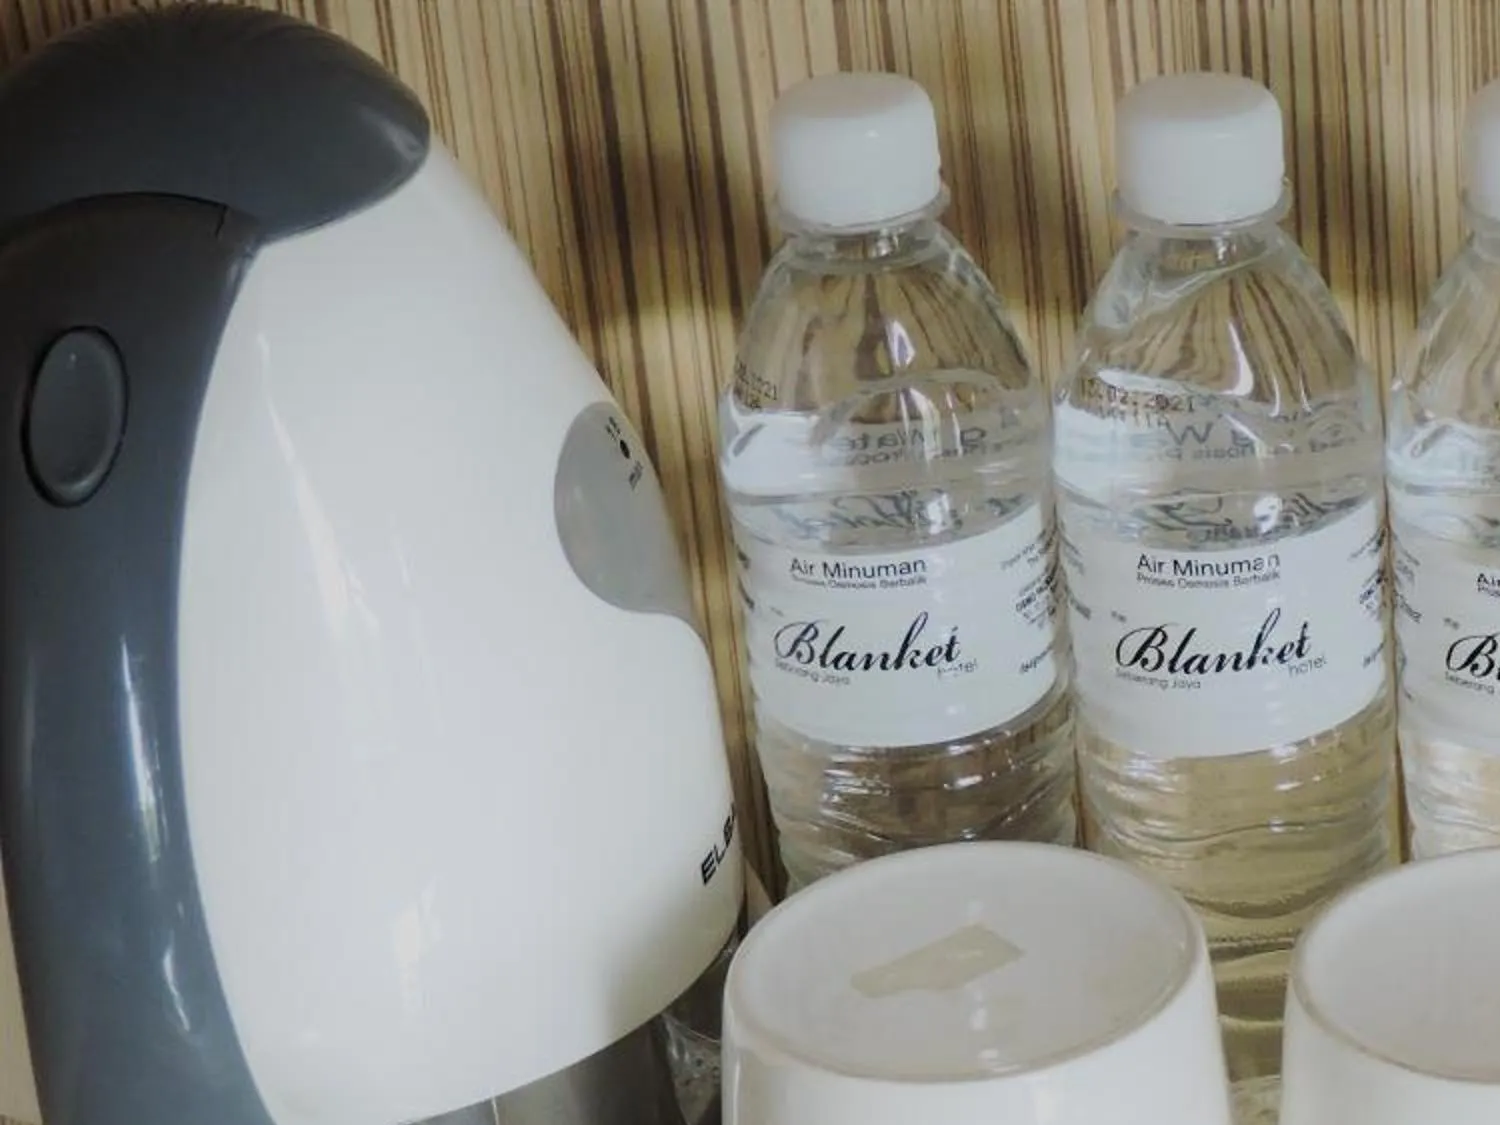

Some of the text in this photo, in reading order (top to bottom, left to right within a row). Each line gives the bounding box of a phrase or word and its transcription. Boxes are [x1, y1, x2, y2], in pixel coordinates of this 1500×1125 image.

[790, 557, 927, 580] Air Minuman
[1137, 552, 1281, 578] Air Minuman
[774, 611, 961, 672] Blanket
[1115, 606, 1312, 676] Blanket
[701, 803, 735, 886] ELB
